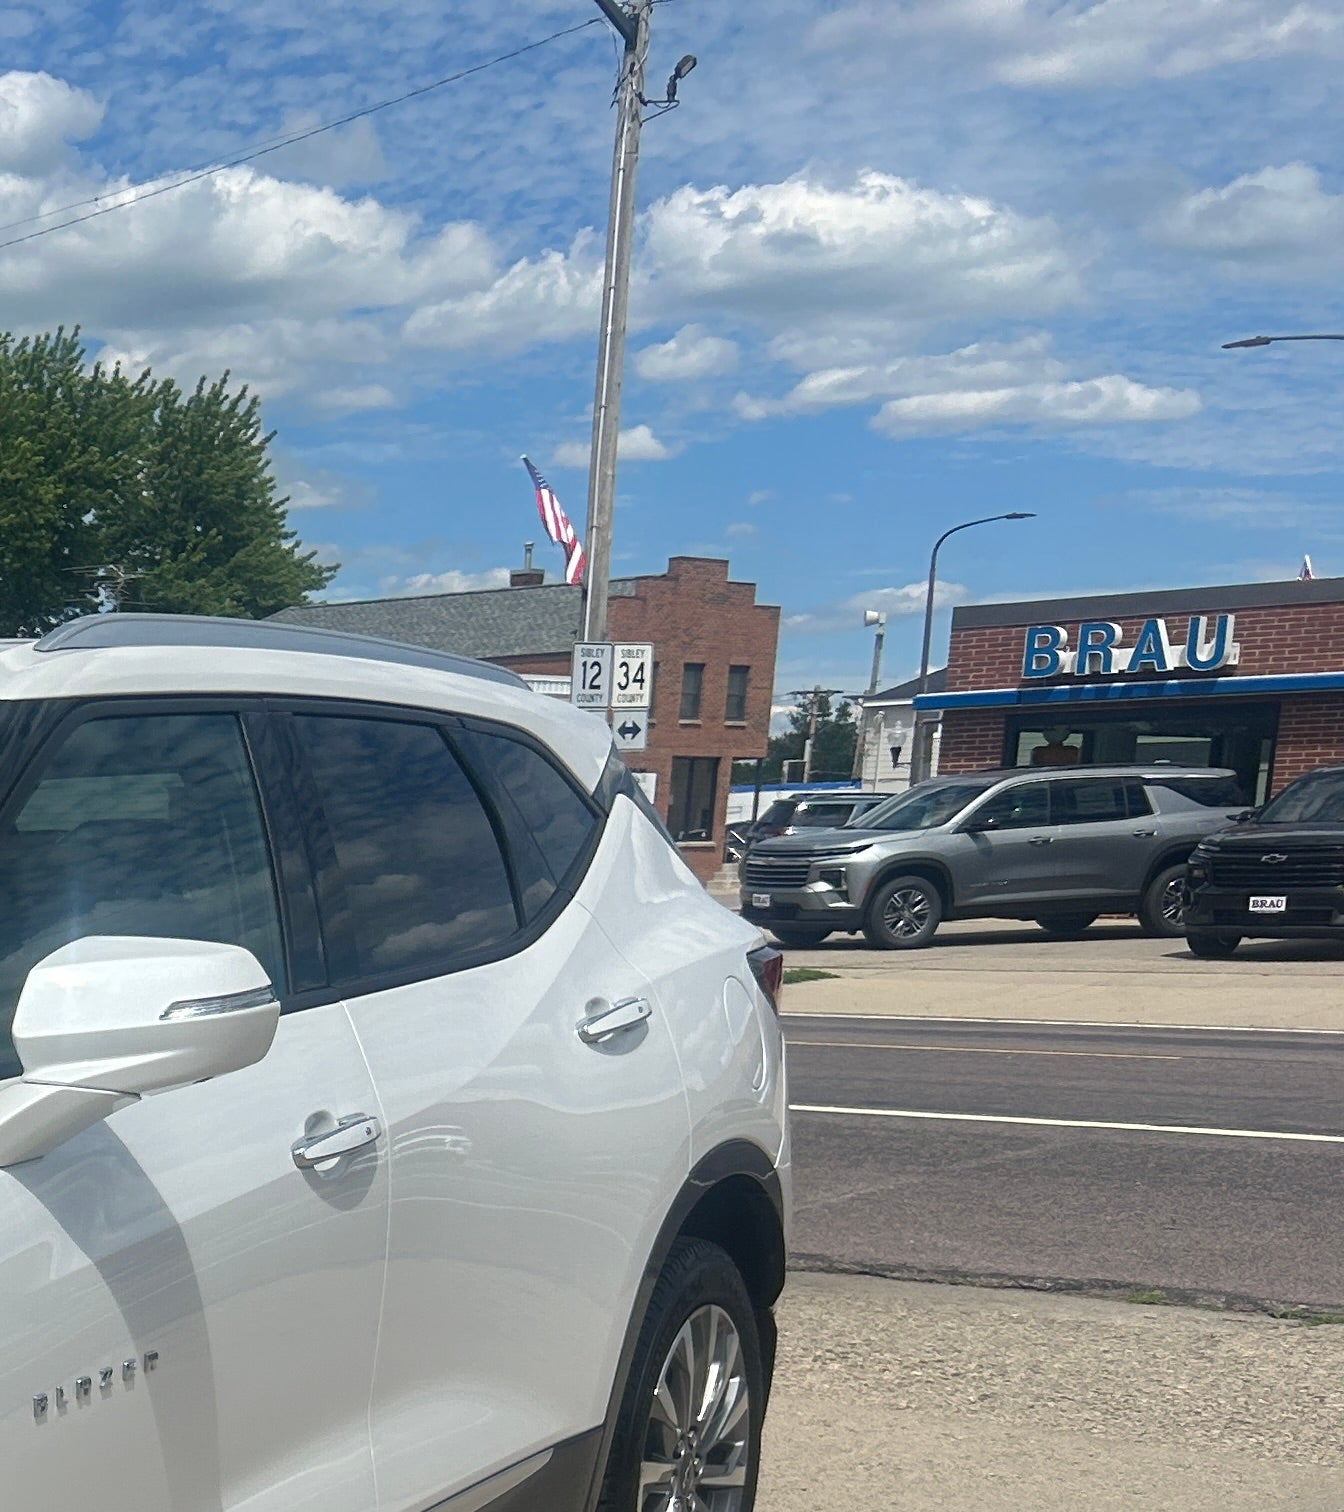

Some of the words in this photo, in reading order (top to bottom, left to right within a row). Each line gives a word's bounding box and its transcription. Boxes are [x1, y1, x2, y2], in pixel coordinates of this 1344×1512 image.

[1022, 613, 1234, 679] BRAU
[580, 647, 605, 658] SIBLEY
[620, 648, 646, 658] SIBLEY
[582, 661, 602, 690] 12
[617, 661, 645, 690] 34
[576, 693, 603, 703] COUNTY
[617, 693, 644, 703] COUNTY
[1252, 900, 1283, 908] BRAU
[33, 1350, 160, 1418] BLAZER
